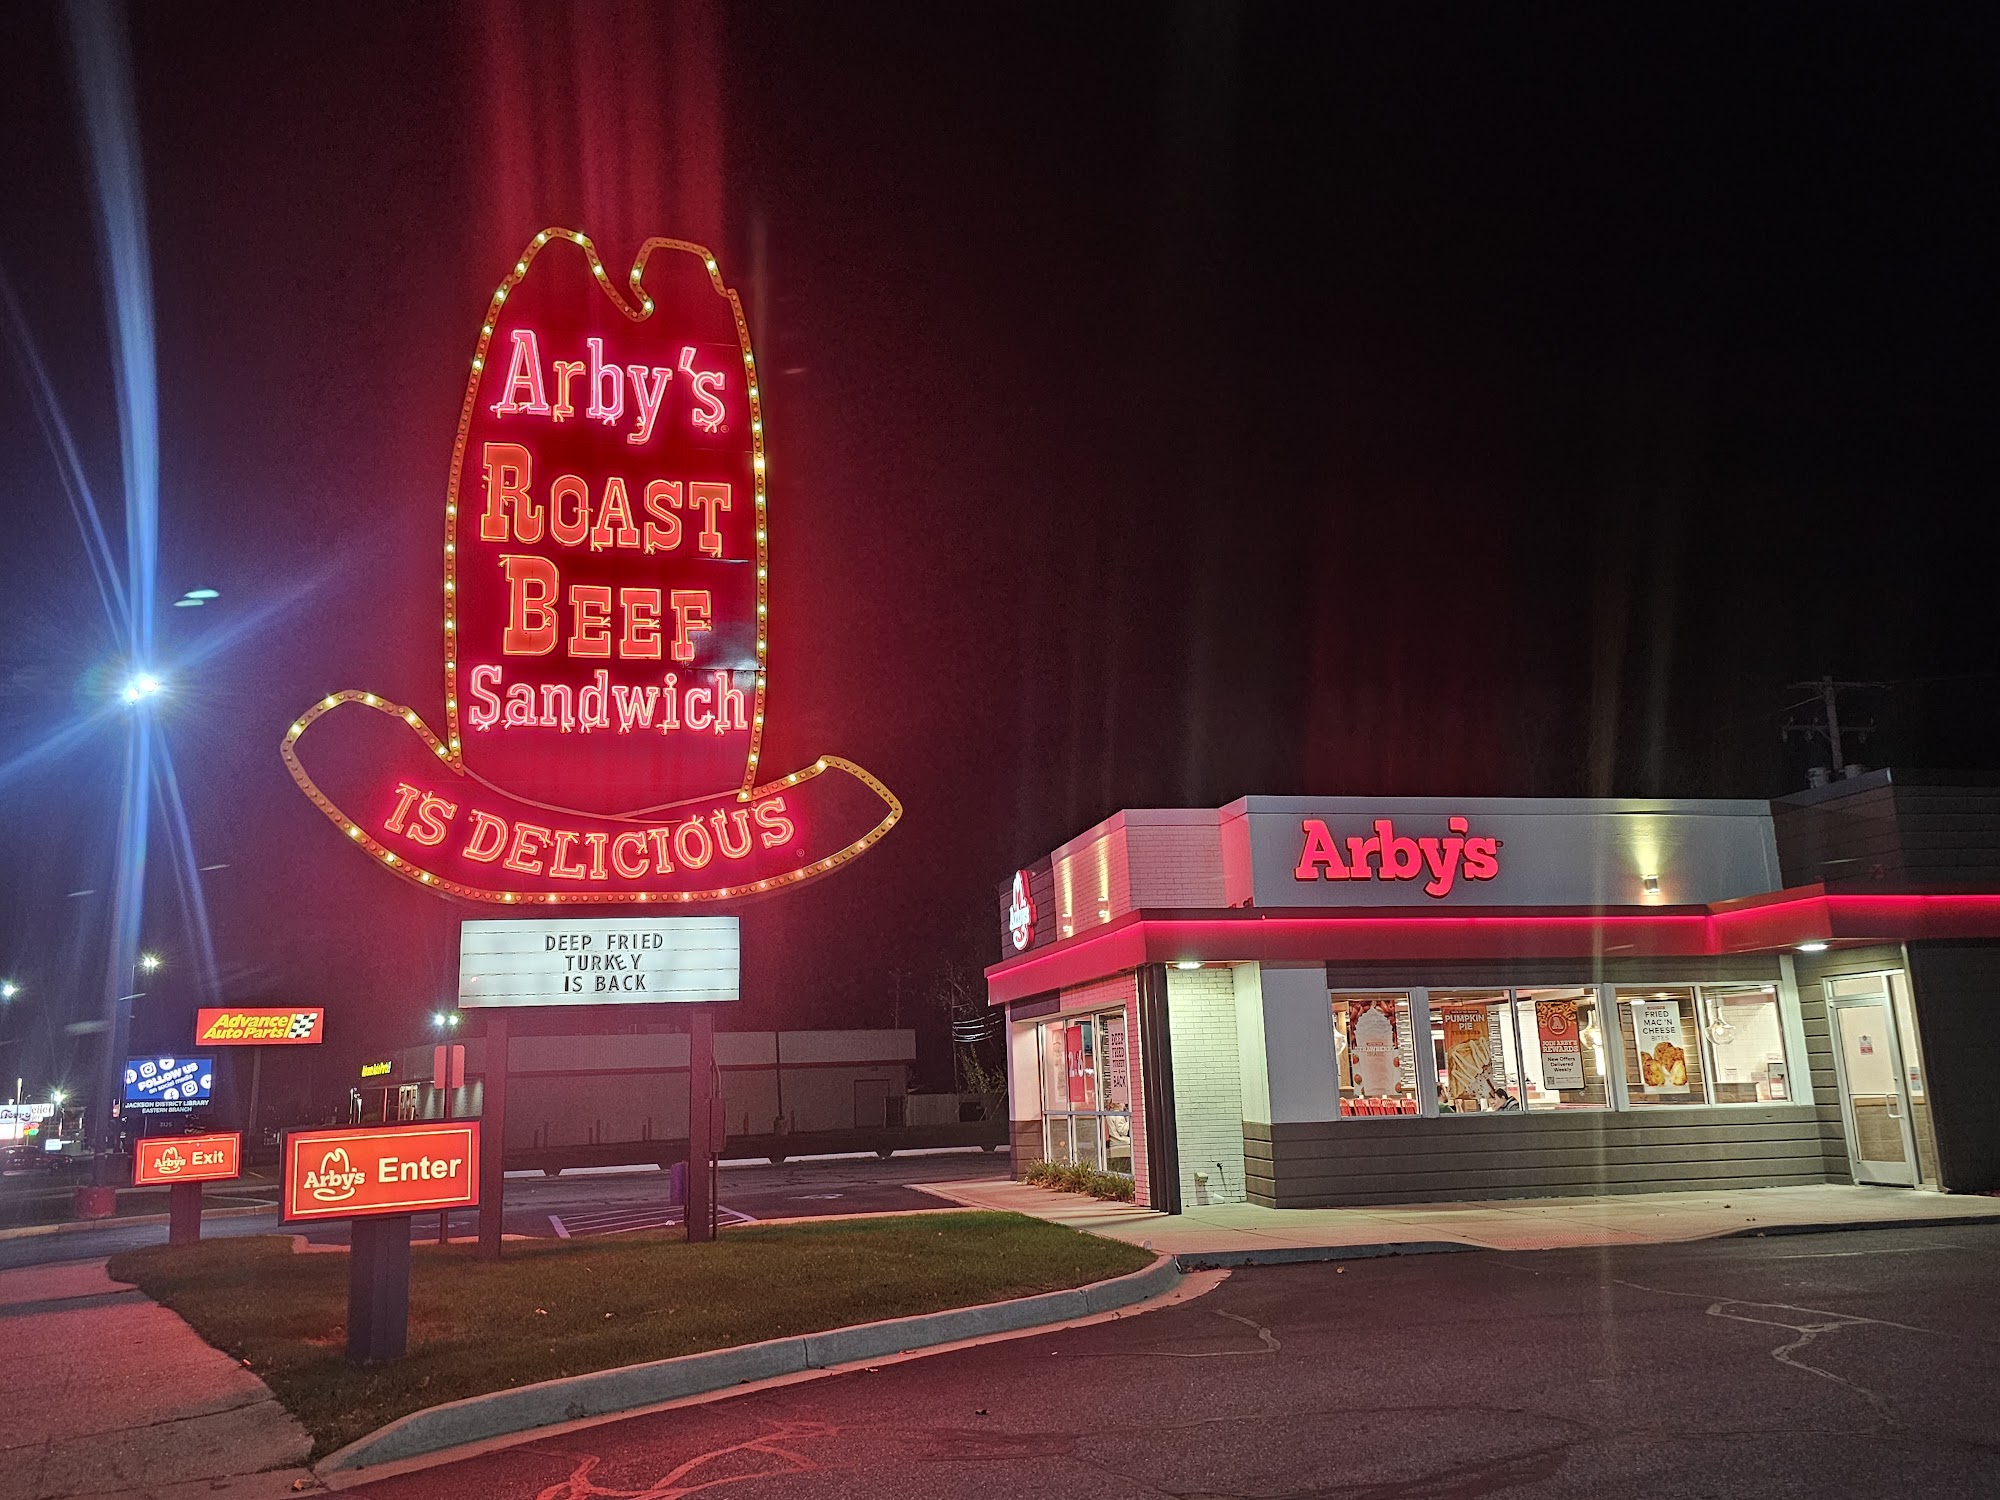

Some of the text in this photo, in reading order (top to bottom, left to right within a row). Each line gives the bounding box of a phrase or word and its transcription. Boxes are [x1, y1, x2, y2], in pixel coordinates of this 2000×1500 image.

[494, 329, 726, 445] Arby's
[480, 442, 732, 553] ROAST
[500, 555, 712, 661] BEEF
[468, 664, 748, 732] Sandwich
[384, 783, 796, 881] IS DELICIOUS
[1295, 817, 1499, 898] Arby's
[545, 932, 664, 952] DEEP FRIED
[564, 953, 643, 972] TURKEY
[563, 974, 648, 993] IS BACK
[212, 1013, 289, 1028] Advance
[1444, 1014, 1485, 1023] PUMPKIN
[1644, 1010, 1669, 1018] FRIED
[202, 1027, 285, 1039] Auto Parts
[1458, 1022, 1474, 1031] PIE
[1642, 1026, 1676, 1034] CHEESE
[138, 1062, 199, 1092] FOLLOW US
[148, 1074, 194, 1095] on social media
[153, 1150, 224, 1169] Arby's Exit
[303, 1155, 462, 1190] Arby's Enter
